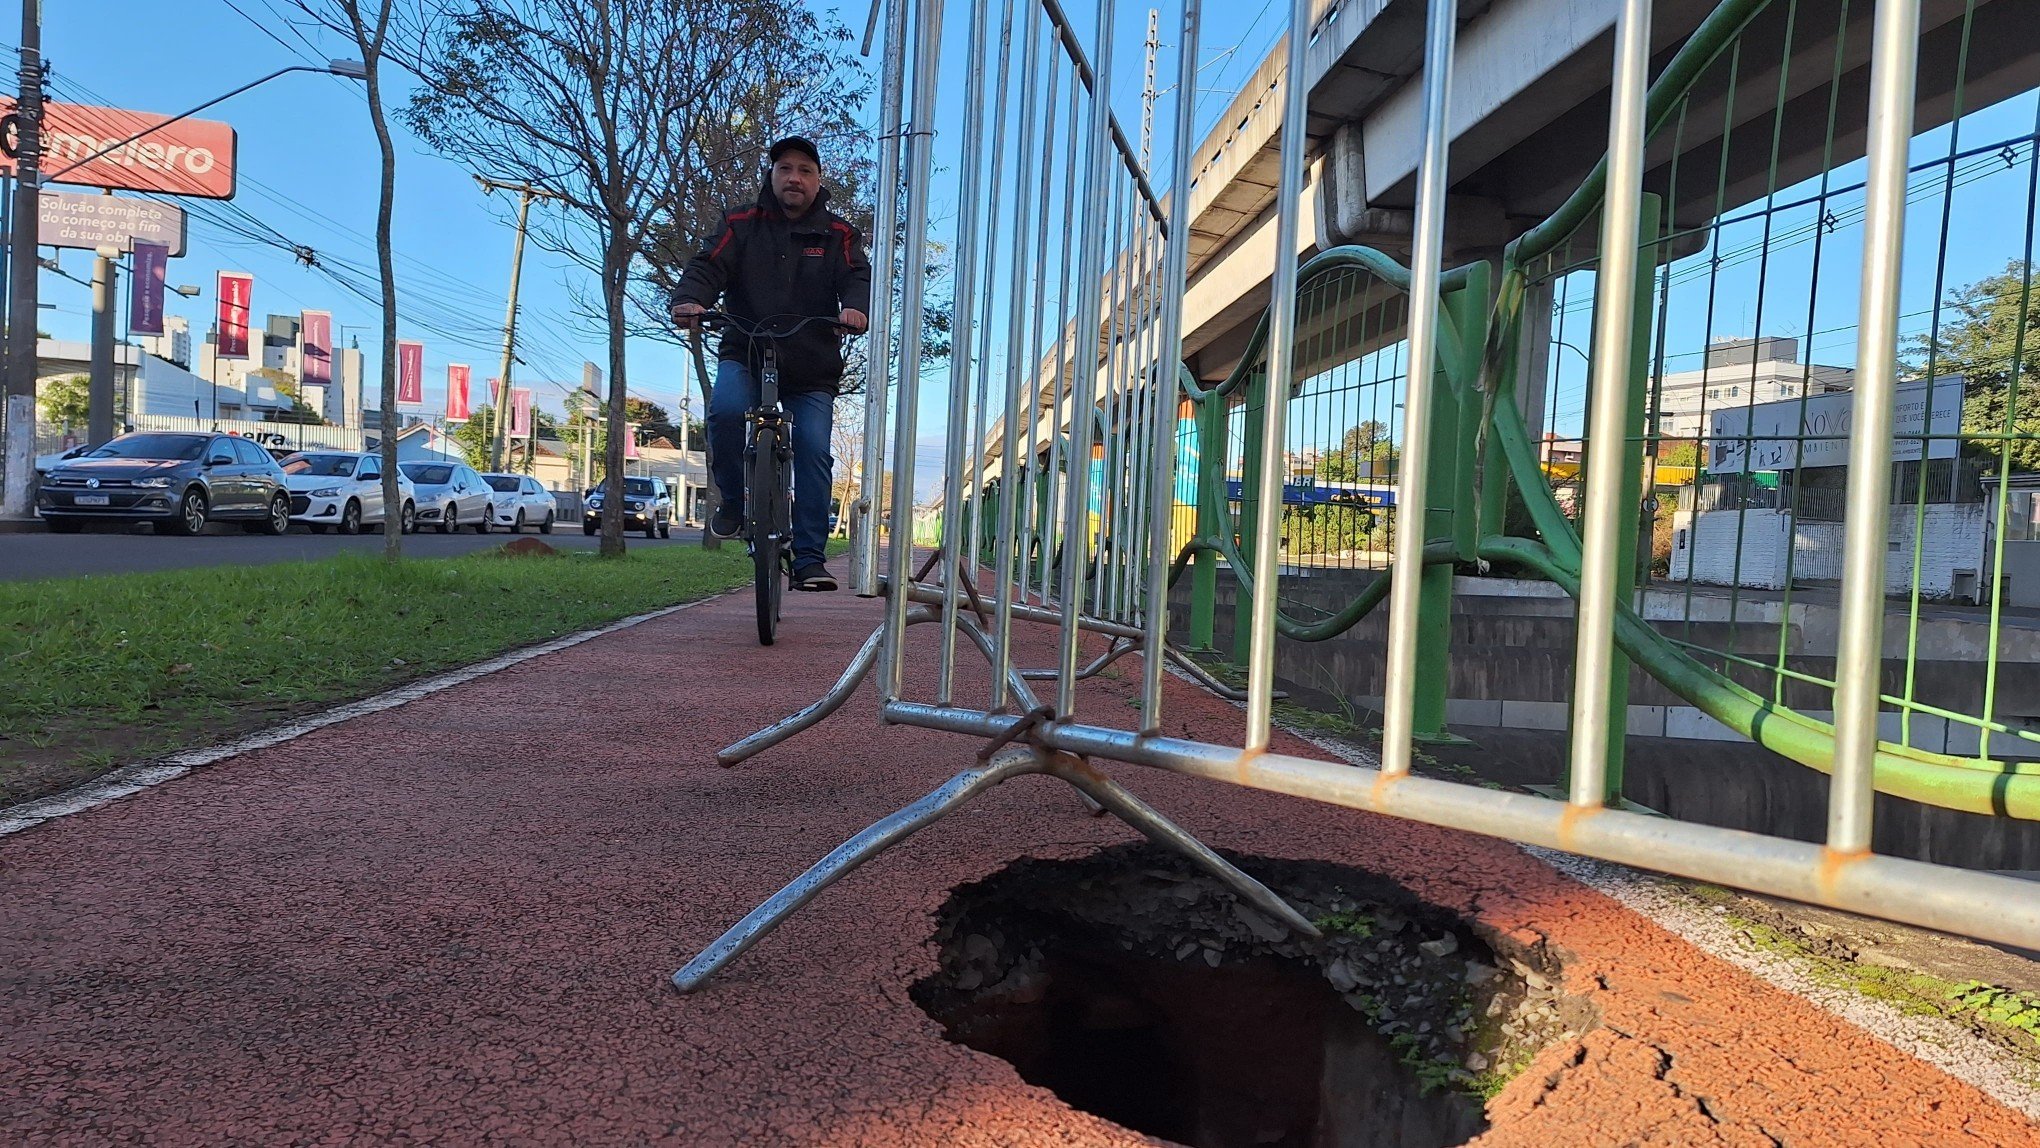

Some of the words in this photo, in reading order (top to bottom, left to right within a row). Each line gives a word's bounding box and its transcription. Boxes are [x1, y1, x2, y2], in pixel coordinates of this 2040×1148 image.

[40, 197, 95, 215] Solução
[98, 204, 162, 220] completa
[41, 211, 59, 224] do
[62, 215, 116, 231] começo
[118, 221, 135, 231] ao
[138, 219, 161, 233] fim
[60, 226, 77, 239] da
[80, 231, 103, 241] sua
[106, 231, 130, 244] obr
[1895, 403, 1919, 412] NFORTO
[1931, 410, 1951, 419] ERECE
[1294, 477, 1312, 487] BR
